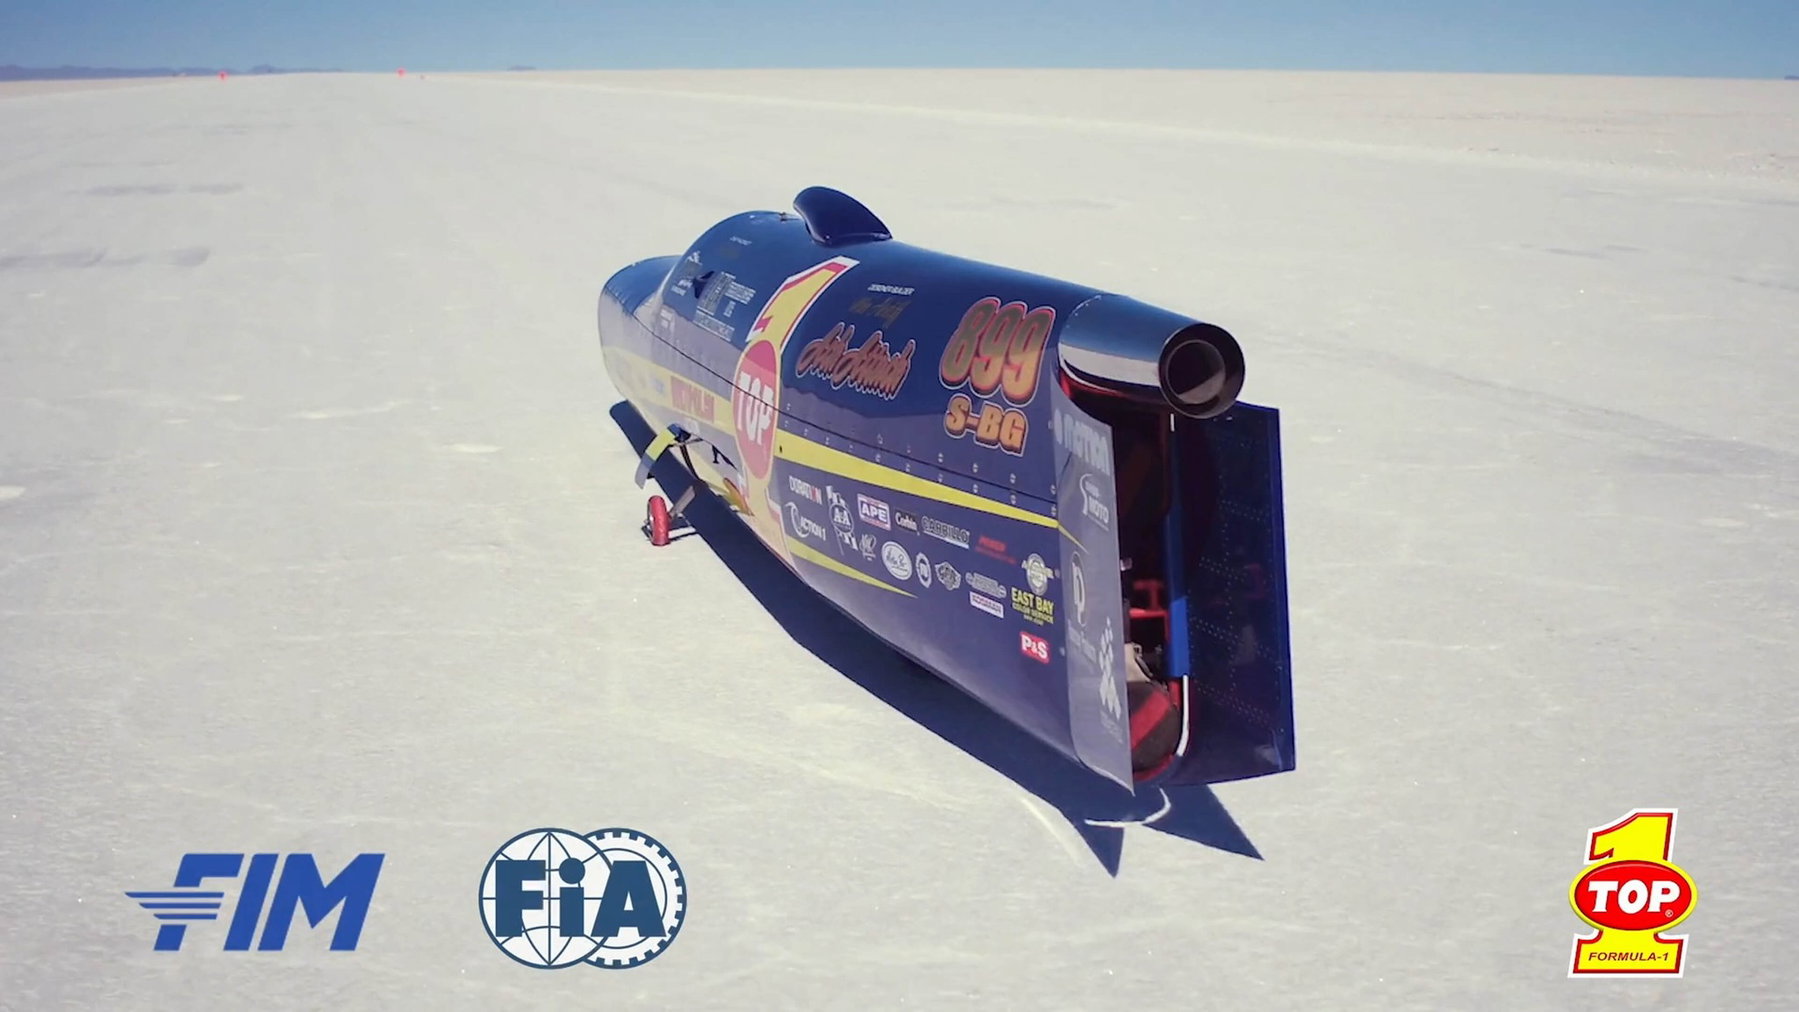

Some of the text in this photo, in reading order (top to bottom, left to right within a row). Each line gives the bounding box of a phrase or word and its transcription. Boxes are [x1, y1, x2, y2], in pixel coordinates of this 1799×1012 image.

[939, 297, 1056, 407] 899
[737, 371, 774, 446] TOP
[944, 393, 1028, 457] S-BG
[861, 502, 888, 523] APE
[1011, 587, 1034, 611] EAST
[1035, 596, 1055, 617] BAY
[1021, 633, 1048, 660] P&S
